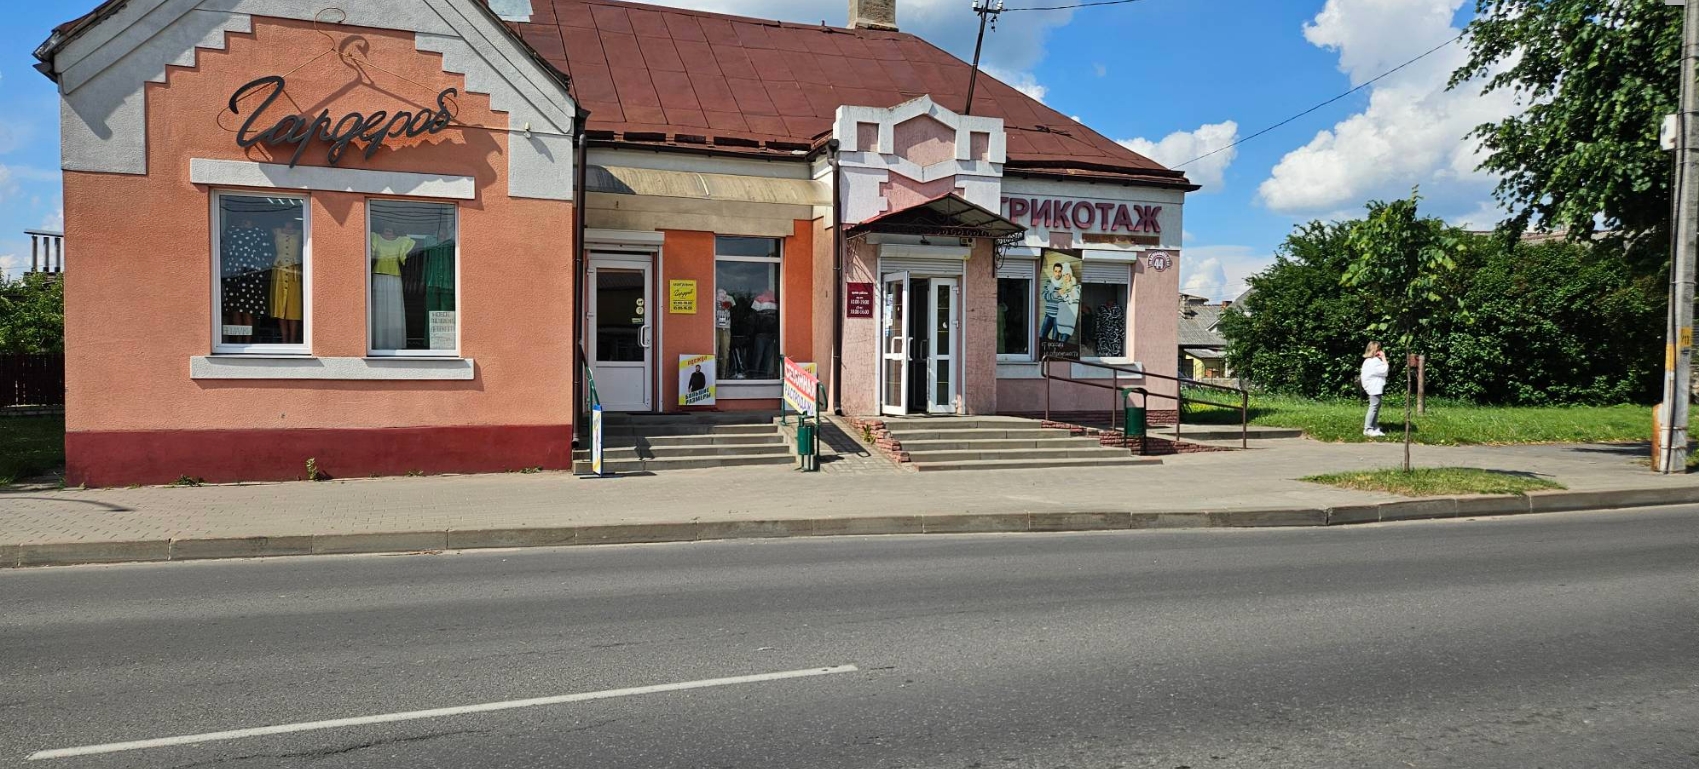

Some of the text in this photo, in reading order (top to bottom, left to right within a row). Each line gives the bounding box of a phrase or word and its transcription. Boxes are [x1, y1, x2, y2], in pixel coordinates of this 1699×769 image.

[229, 76, 457, 169] Гардероб
[1154, 258, 1164, 269] 44
[685, 393, 711, 405] РАЗМЕРЫ
